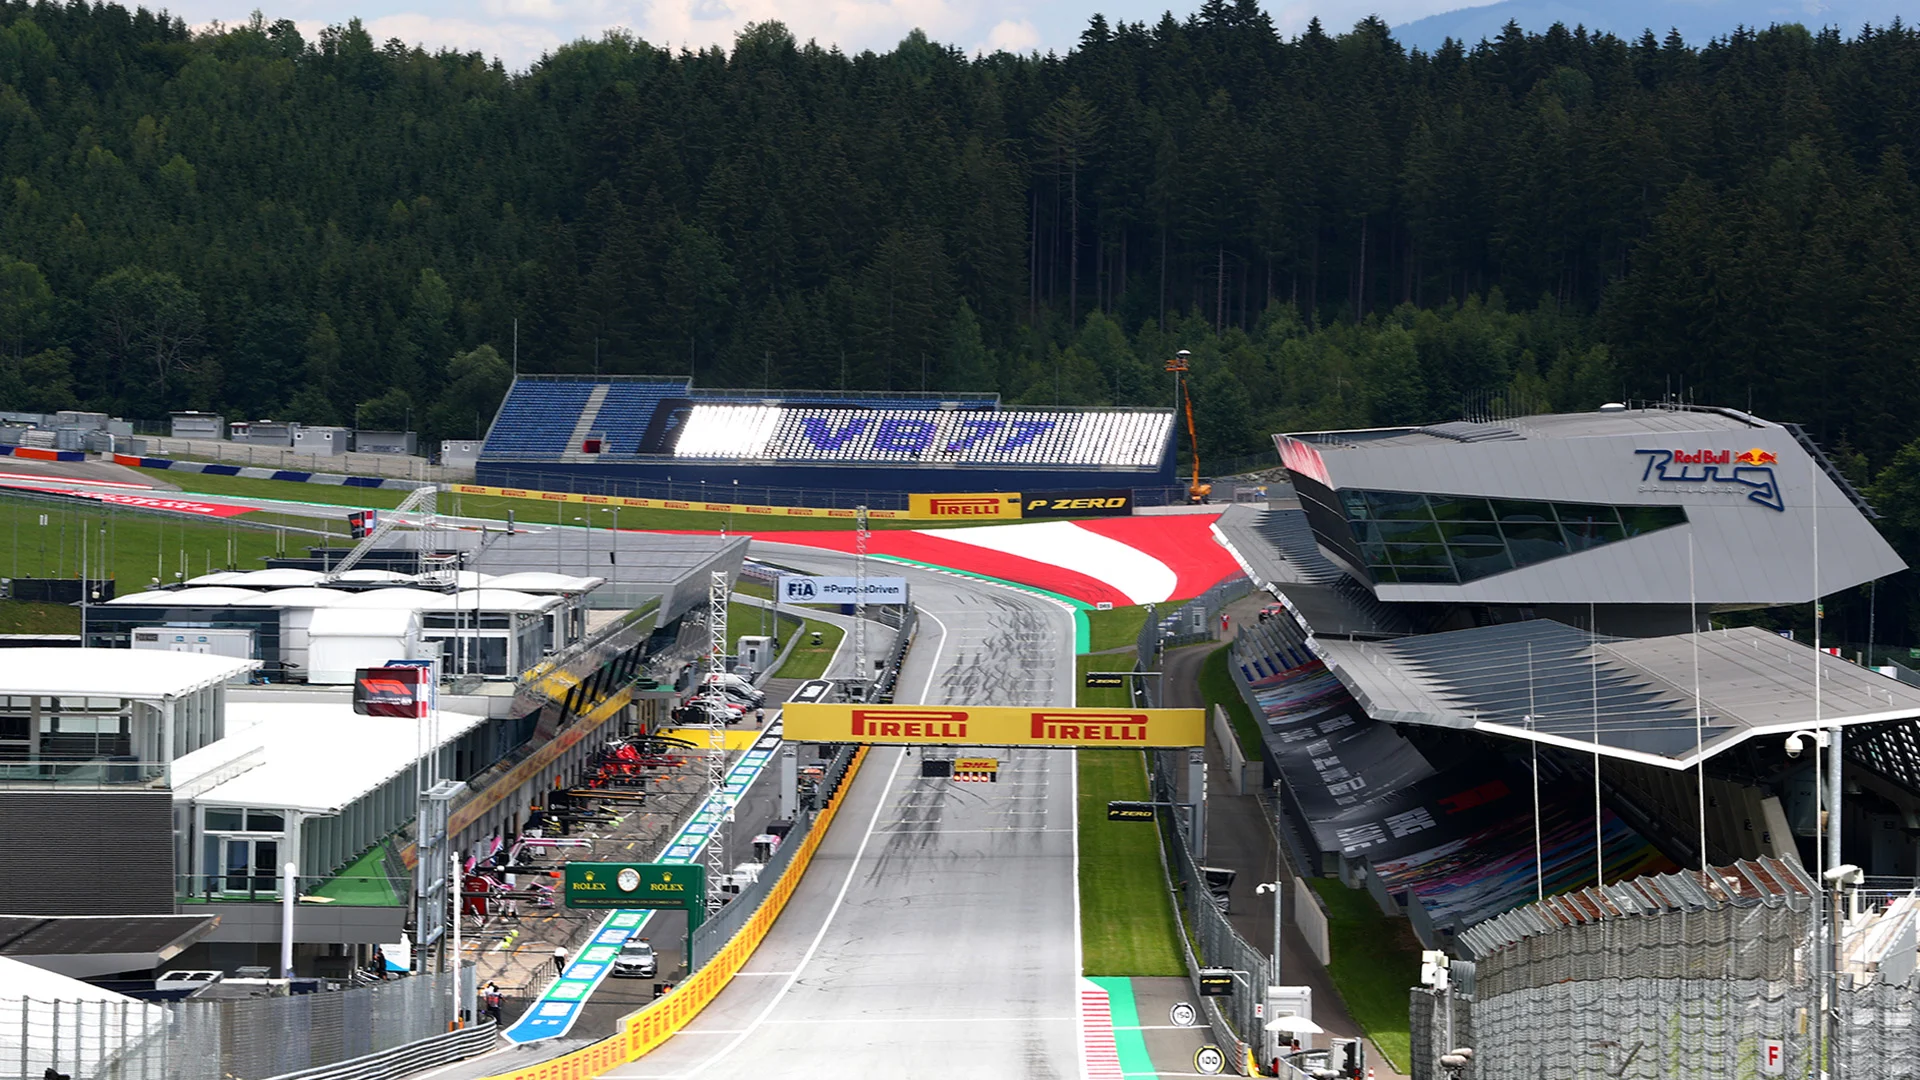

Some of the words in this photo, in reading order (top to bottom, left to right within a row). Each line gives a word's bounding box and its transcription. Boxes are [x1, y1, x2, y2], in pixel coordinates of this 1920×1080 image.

[1674, 450, 1702, 464] Red
[1704, 450, 1730, 464] Bull
[1634, 449, 1785, 512] Ring
[930, 498, 999, 515] PIRELLI
[1027, 499, 1047, 511] P
[1050, 497, 1127, 510] ZERO
[851, 709, 969, 738] PIRELLI
[1031, 712, 1149, 741] PIRELLI
[962, 761, 991, 769] DHL
[572, 882, 607, 891] ROLEX
[650, 883, 684, 892] ROLEX
[1176, 1011, 1190, 1019] 150
[1201, 1056, 1218, 1065] 100
[1768, 1045, 1779, 1066] F
